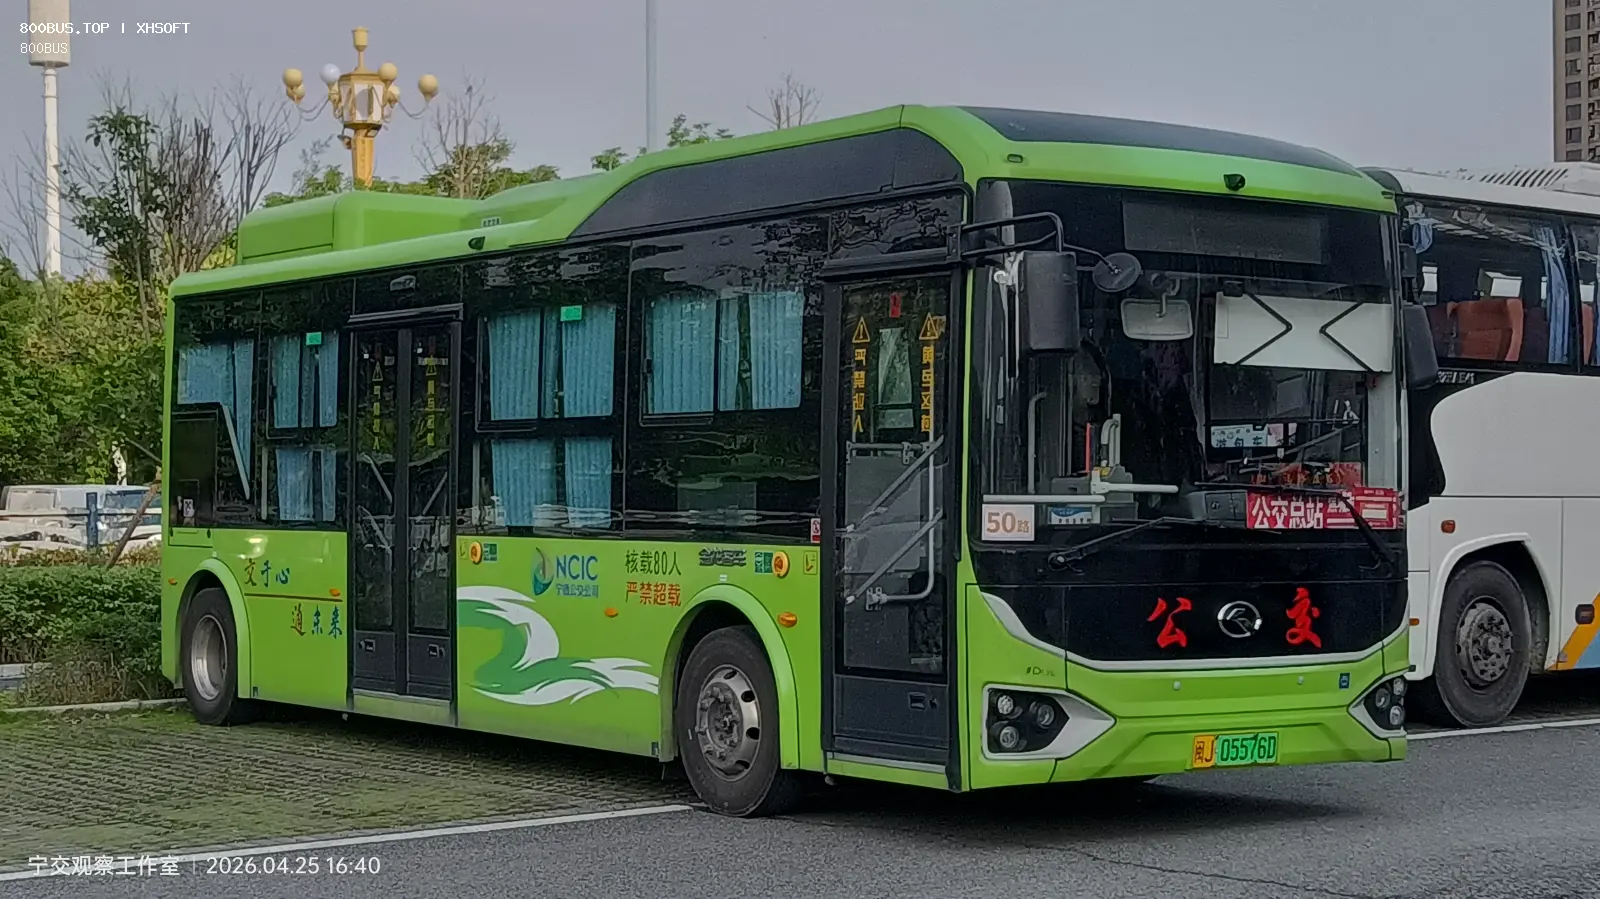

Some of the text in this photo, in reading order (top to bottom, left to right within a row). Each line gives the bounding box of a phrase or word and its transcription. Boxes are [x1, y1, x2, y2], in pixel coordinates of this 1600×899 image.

[986, 512, 1029, 533] 50路
[1252, 496, 1323, 529] 公交总站
[556, 554, 598, 580] NCIC
[625, 549, 682, 576] 核载80人
[626, 581, 681, 606] 严禁超载
[1147, 597, 1192, 648] 公
[1220, 736, 1277, 762] 05576D
